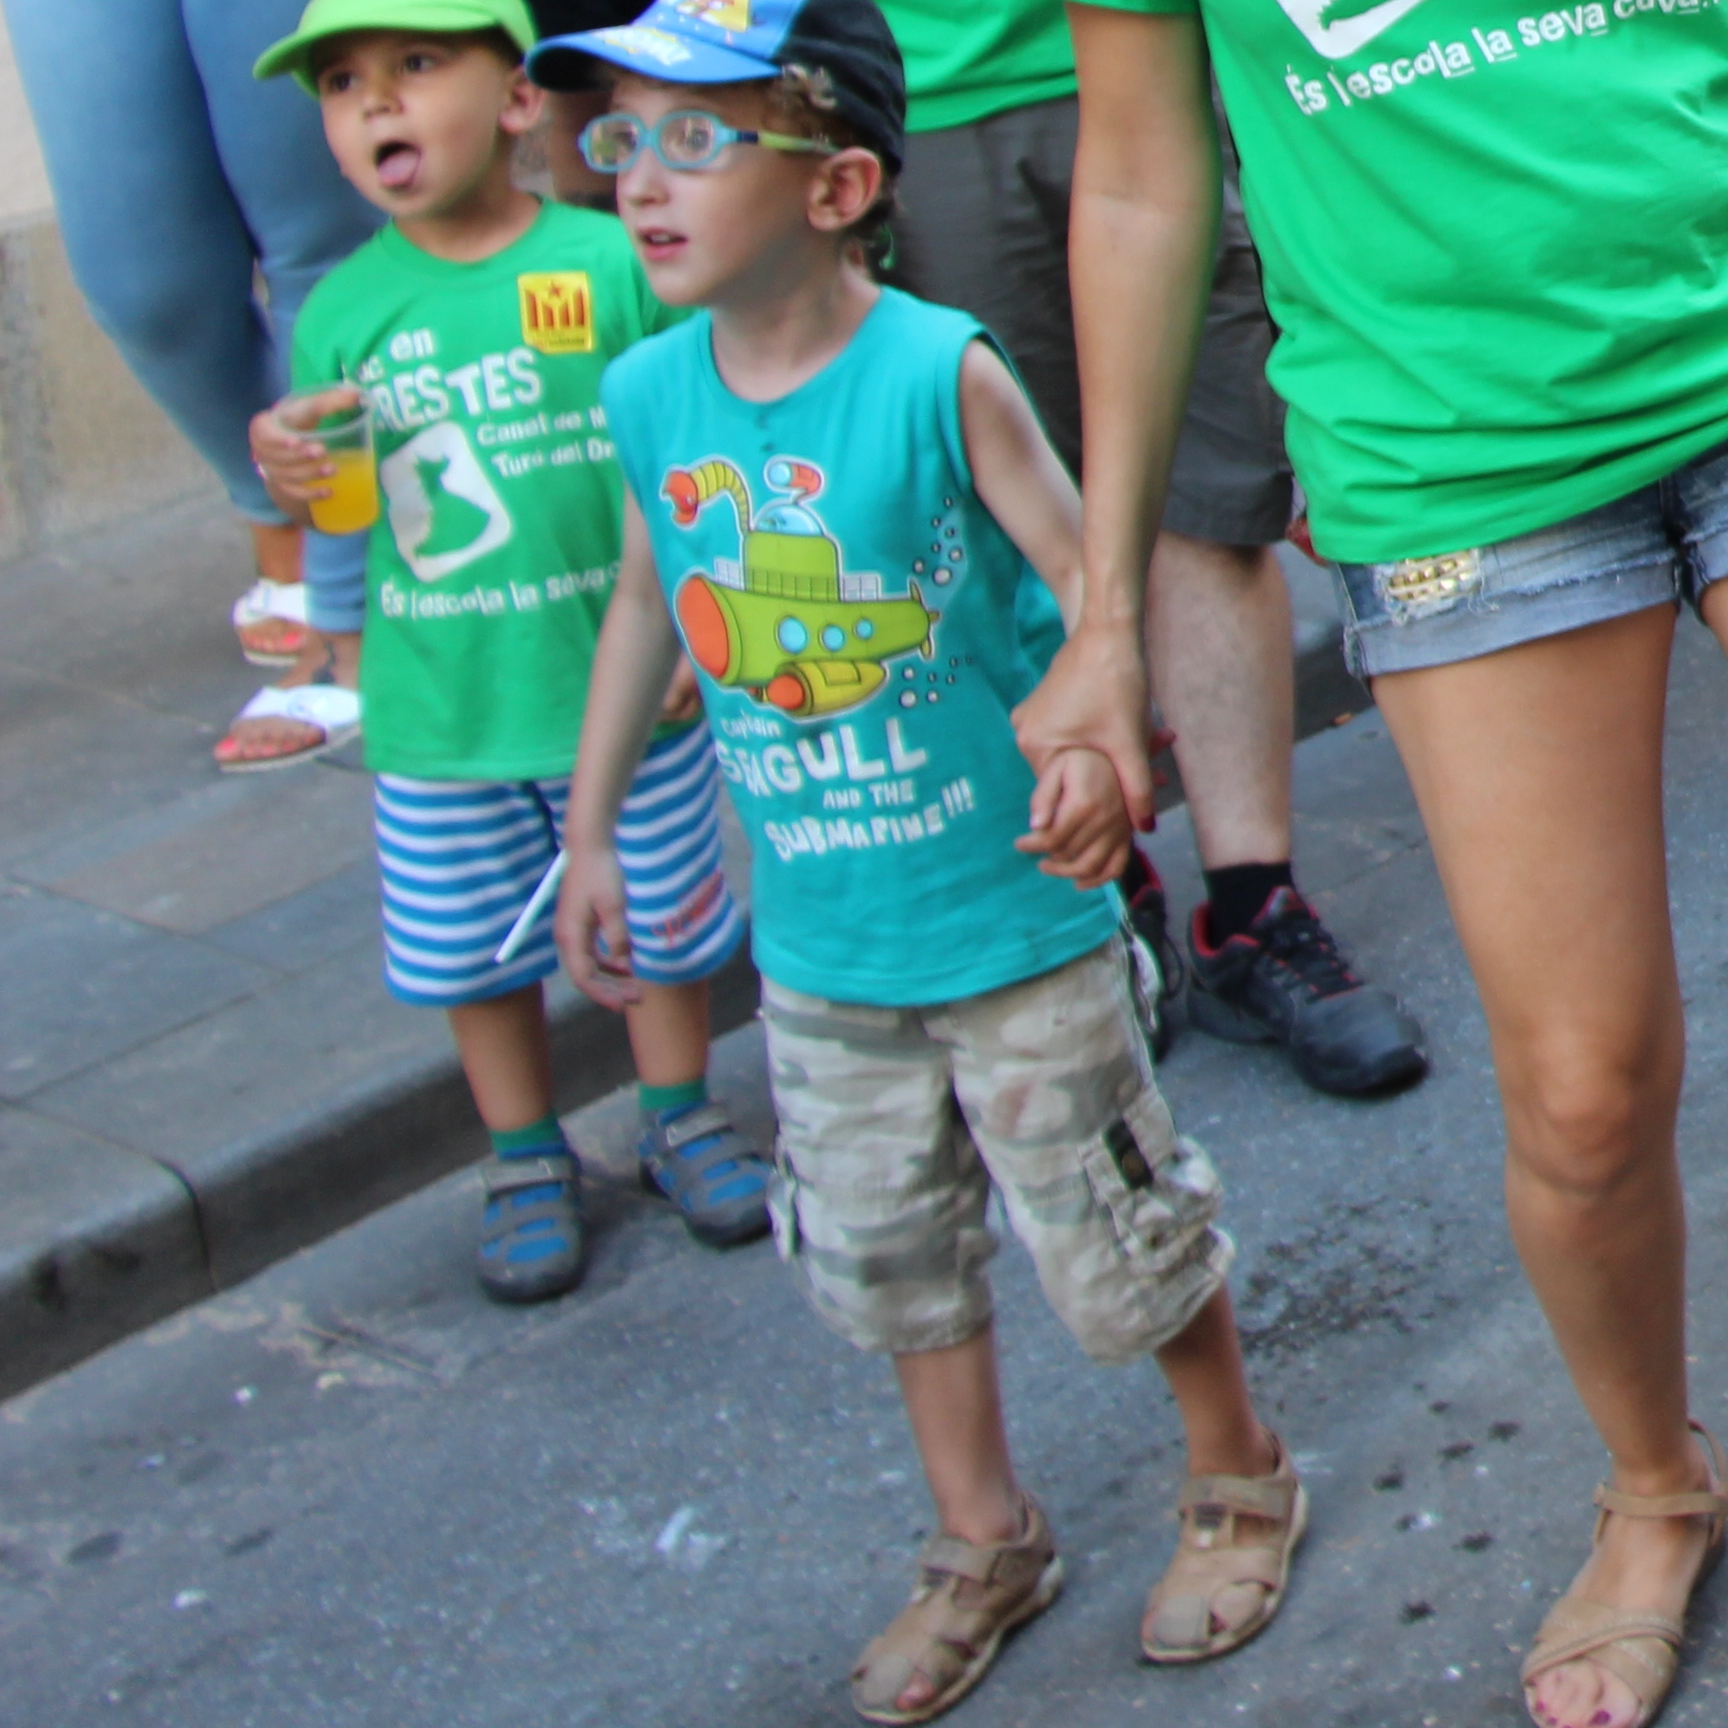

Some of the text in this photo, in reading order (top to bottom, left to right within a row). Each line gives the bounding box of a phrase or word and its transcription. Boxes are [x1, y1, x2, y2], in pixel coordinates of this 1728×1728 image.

[1471, 27, 1518, 63] la
[1517, 2, 1609, 48] seva
[389, 327, 436, 363] en
[373, 346, 543, 434] RESTES
[476, 411, 549, 448] Canet
[553, 408, 583, 432] de
[549, 440, 584, 468] del
[509, 579, 541, 612] la
[544, 566, 607, 601] seva
[822, 778, 916, 810] AND THE
[763, 776, 977, 863] SUBMARINE!!!
